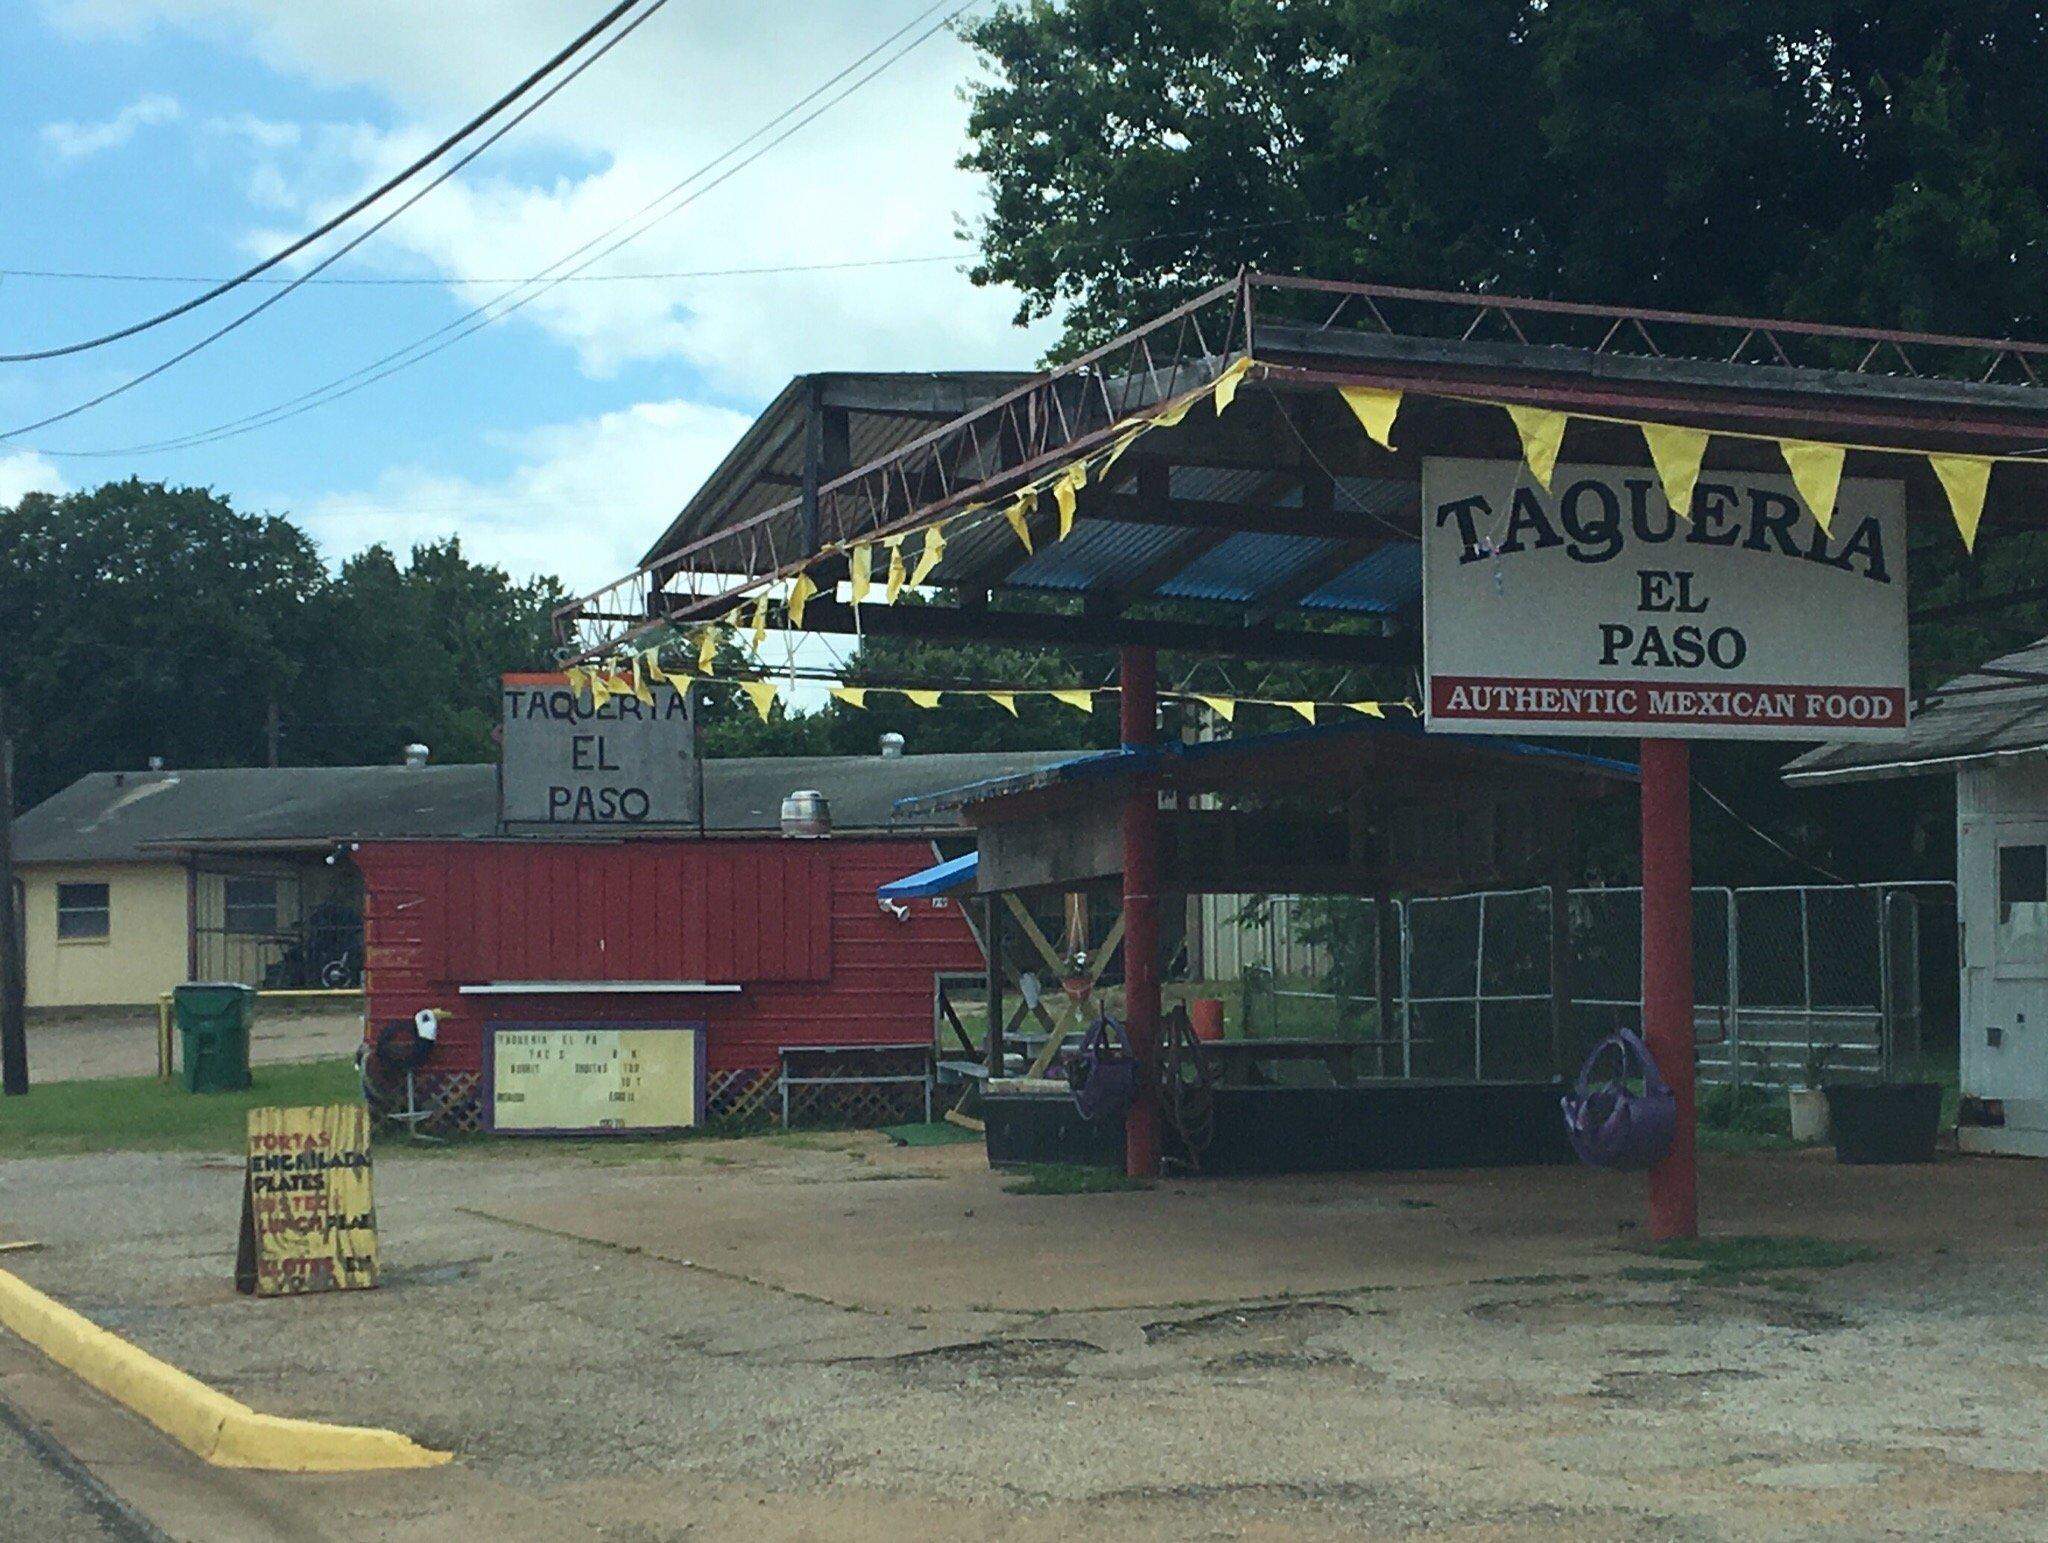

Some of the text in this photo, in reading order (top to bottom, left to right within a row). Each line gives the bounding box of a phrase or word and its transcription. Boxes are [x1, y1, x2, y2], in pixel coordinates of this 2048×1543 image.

[1436, 478, 1891, 584] TAQUERIA
[1636, 570, 1710, 613] EL
[1599, 624, 1747, 669] PASO
[505, 691, 689, 726] TAQUERIA
[1446, 685, 1894, 721] AUTHENTIC MEXICAN FOOD
[572, 735, 620, 771] EL
[549, 786, 651, 823] PASO
[252, 1131, 331, 1150] TORTAS
[253, 1172, 326, 1193] PLATES
